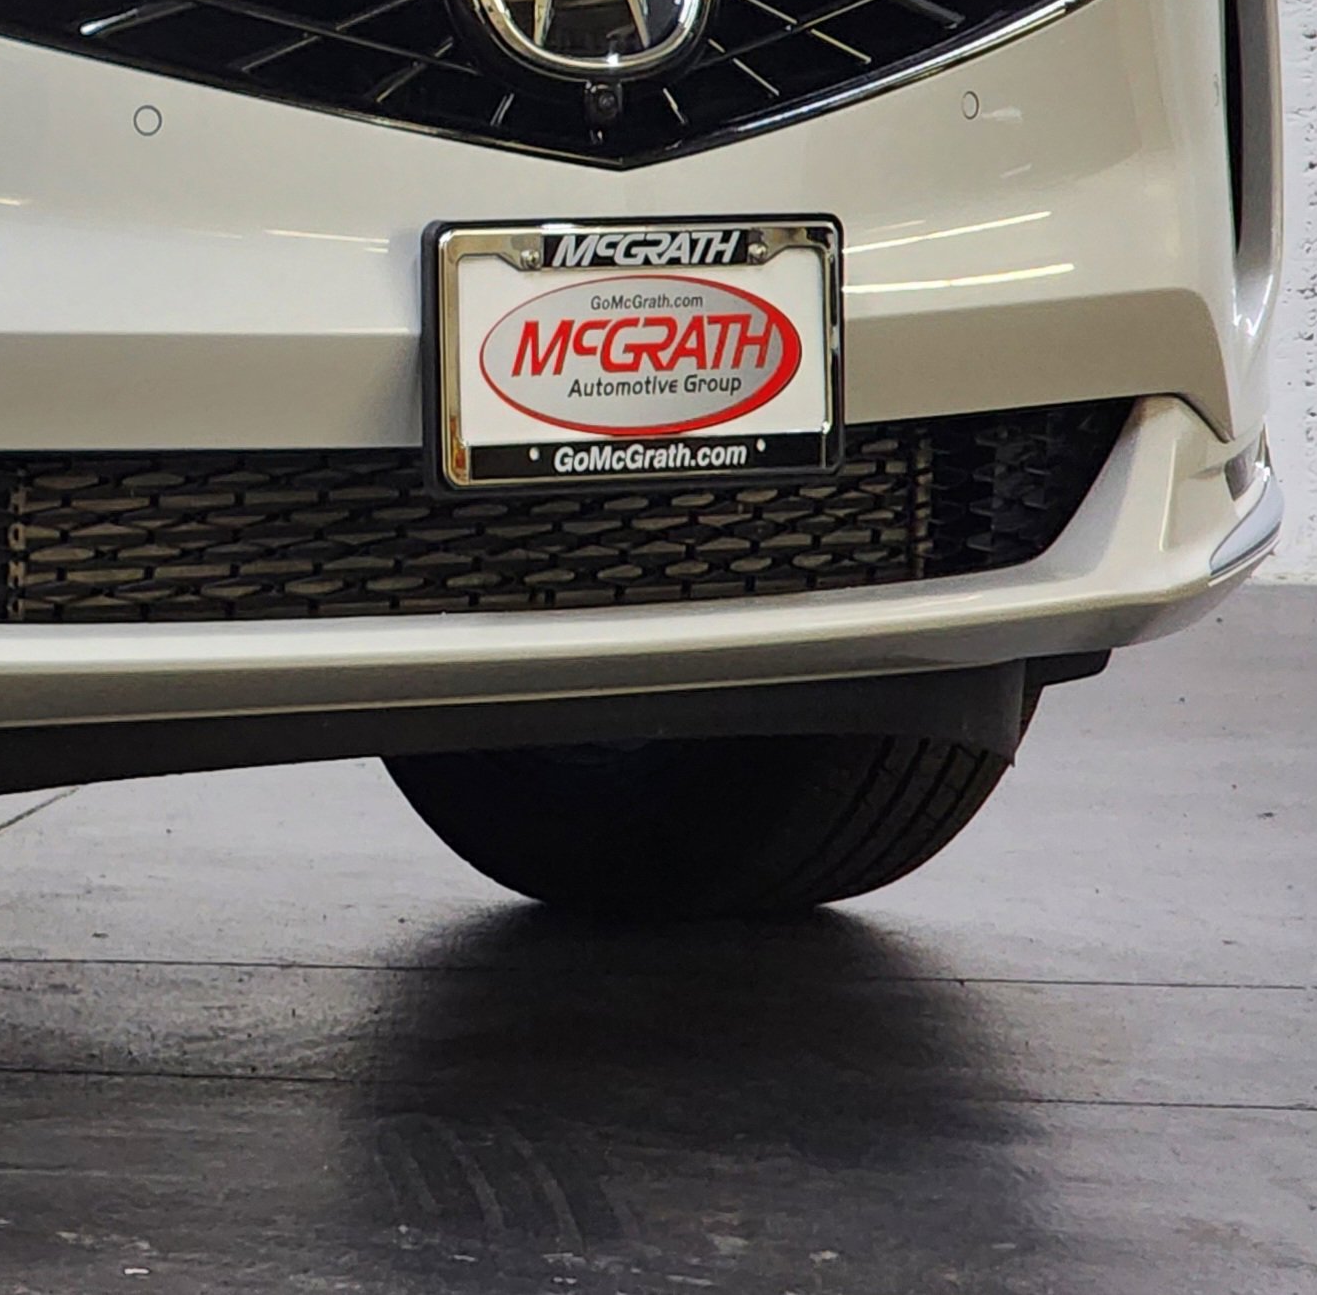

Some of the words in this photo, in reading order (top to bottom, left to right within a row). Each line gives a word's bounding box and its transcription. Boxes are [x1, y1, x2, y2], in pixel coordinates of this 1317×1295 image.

[590, 293, 704, 311] GoMcGrath.com
[568, 376, 678, 398] Automotive
[684, 375, 742, 397] Group
[554, 442, 748, 472] GoMcGrath.com
